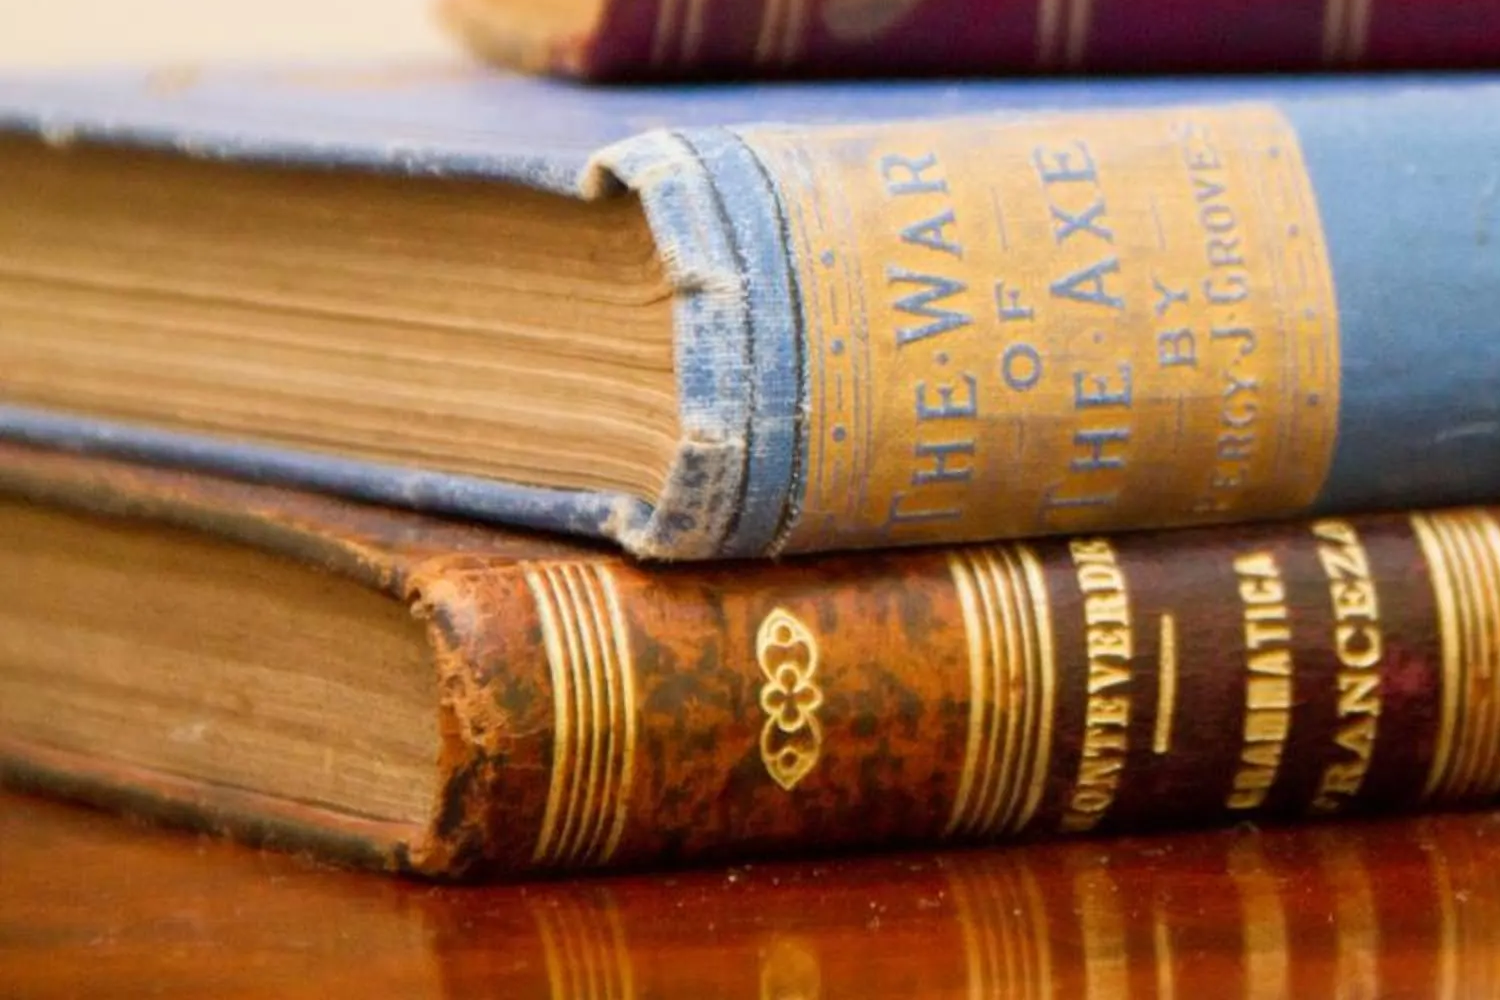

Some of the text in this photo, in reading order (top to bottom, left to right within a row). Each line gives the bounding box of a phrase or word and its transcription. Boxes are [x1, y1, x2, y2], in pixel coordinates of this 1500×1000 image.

[880, 151, 978, 534] THE WAR
[995, 281, 1043, 391] OF
[1033, 139, 1133, 525] THE AXE
[1150, 273, 1197, 370] BY
